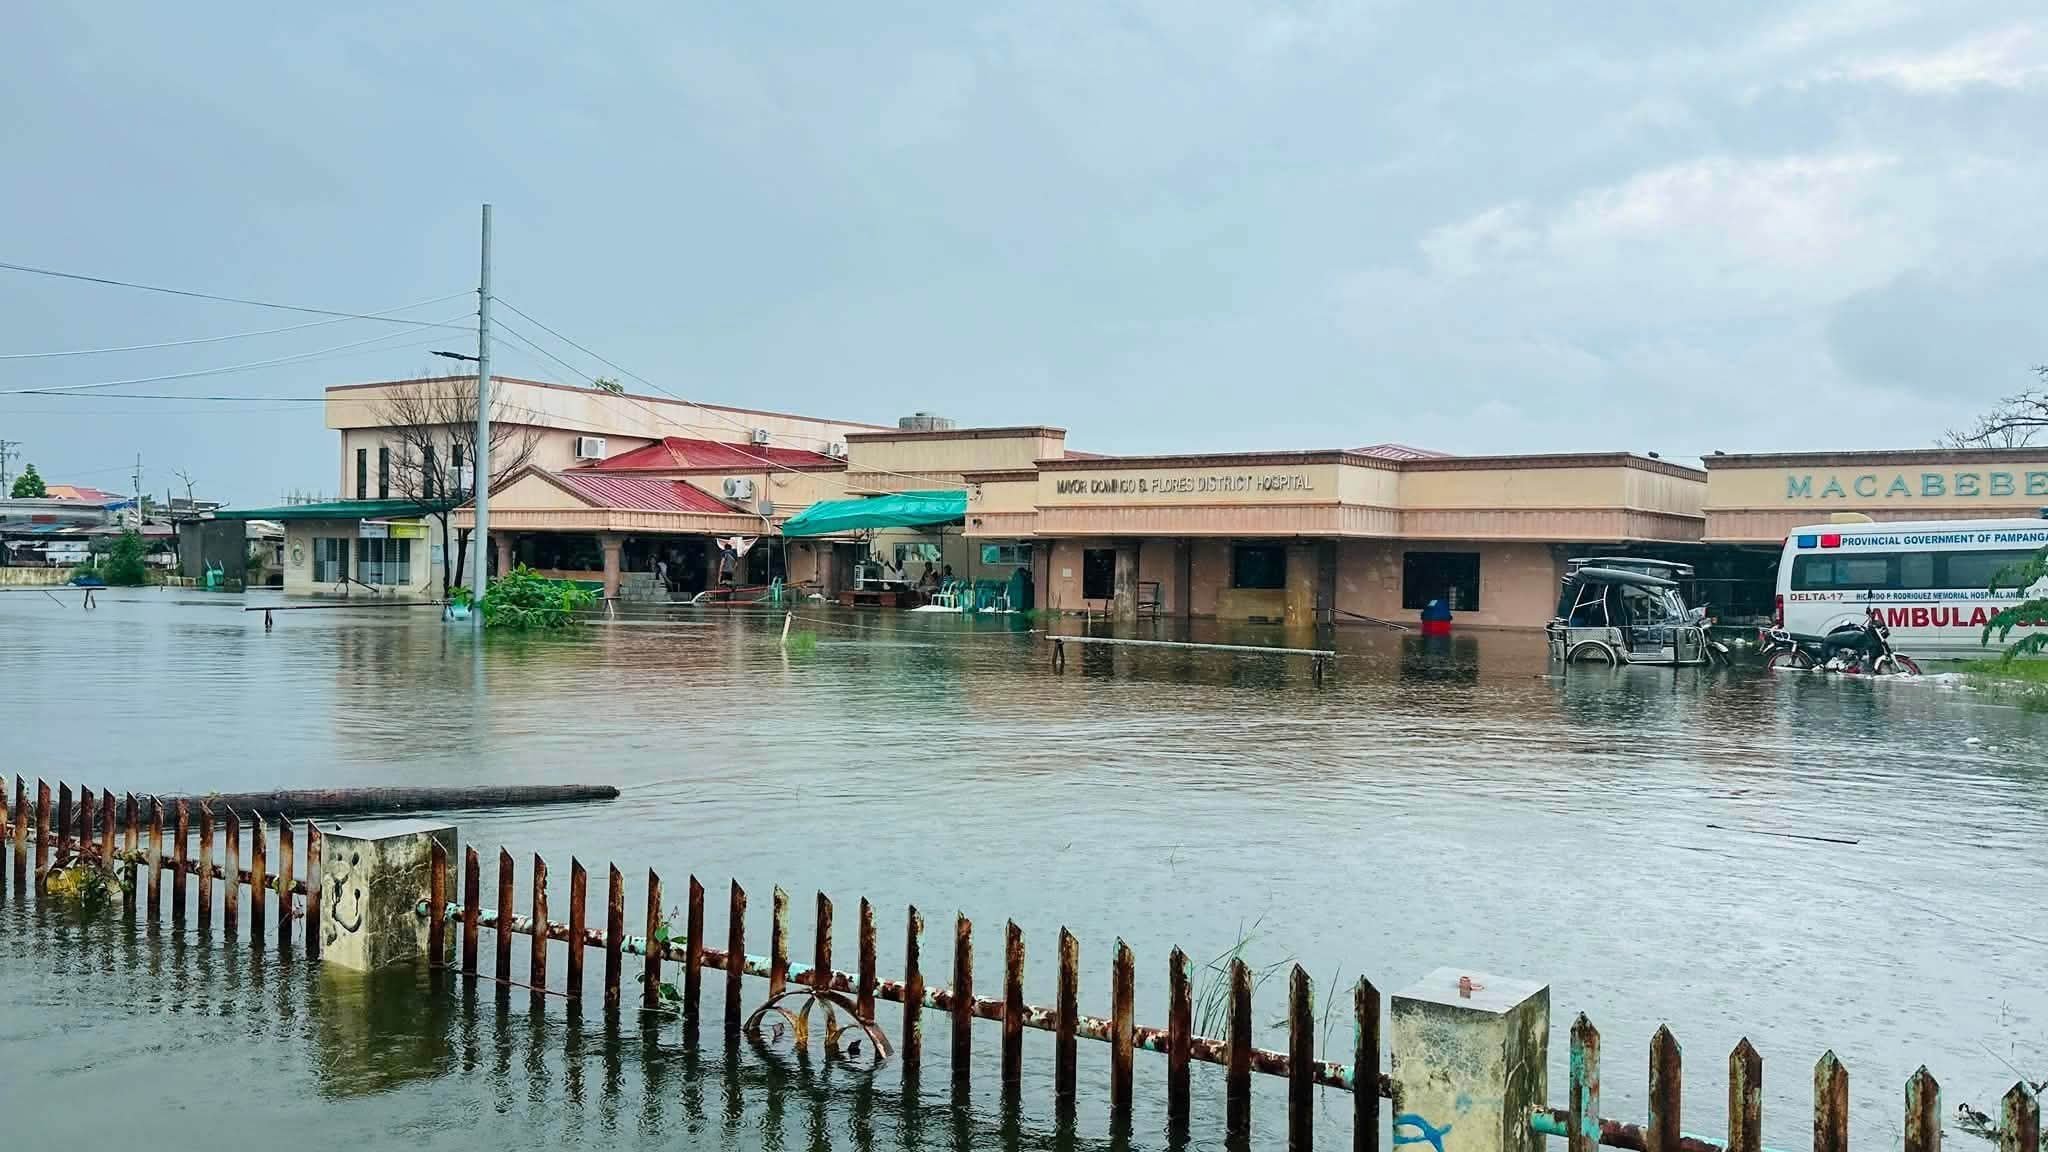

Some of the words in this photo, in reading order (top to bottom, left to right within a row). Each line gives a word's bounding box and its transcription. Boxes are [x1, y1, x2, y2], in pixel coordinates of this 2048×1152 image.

[1057, 479, 1088, 494] MAYOR
[1091, 479, 1136, 493] DOMINGO
[1152, 477, 1194, 493] FLORES
[1198, 475, 1252, 491] DISTRICT
[1257, 473, 1314, 490] HOSPITAL
[1787, 471, 2048, 497] MACABEBE
[1842, 536, 1900, 546] PROVINCIAL
[1903, 534, 1975, 545] GOVERNMENT
[1977, 534, 1991, 543] OF
[1790, 592, 1844, 601] DELTA-17
[1856, 592, 1885, 601] RICRDO
[1893, 592, 1932, 600] RODRIGUEZ
[1932, 591, 1969, 600] MEMORIAL
[2005, 590, 2030, 599] ANX
[1871, 606, 2048, 628] AMBULA
